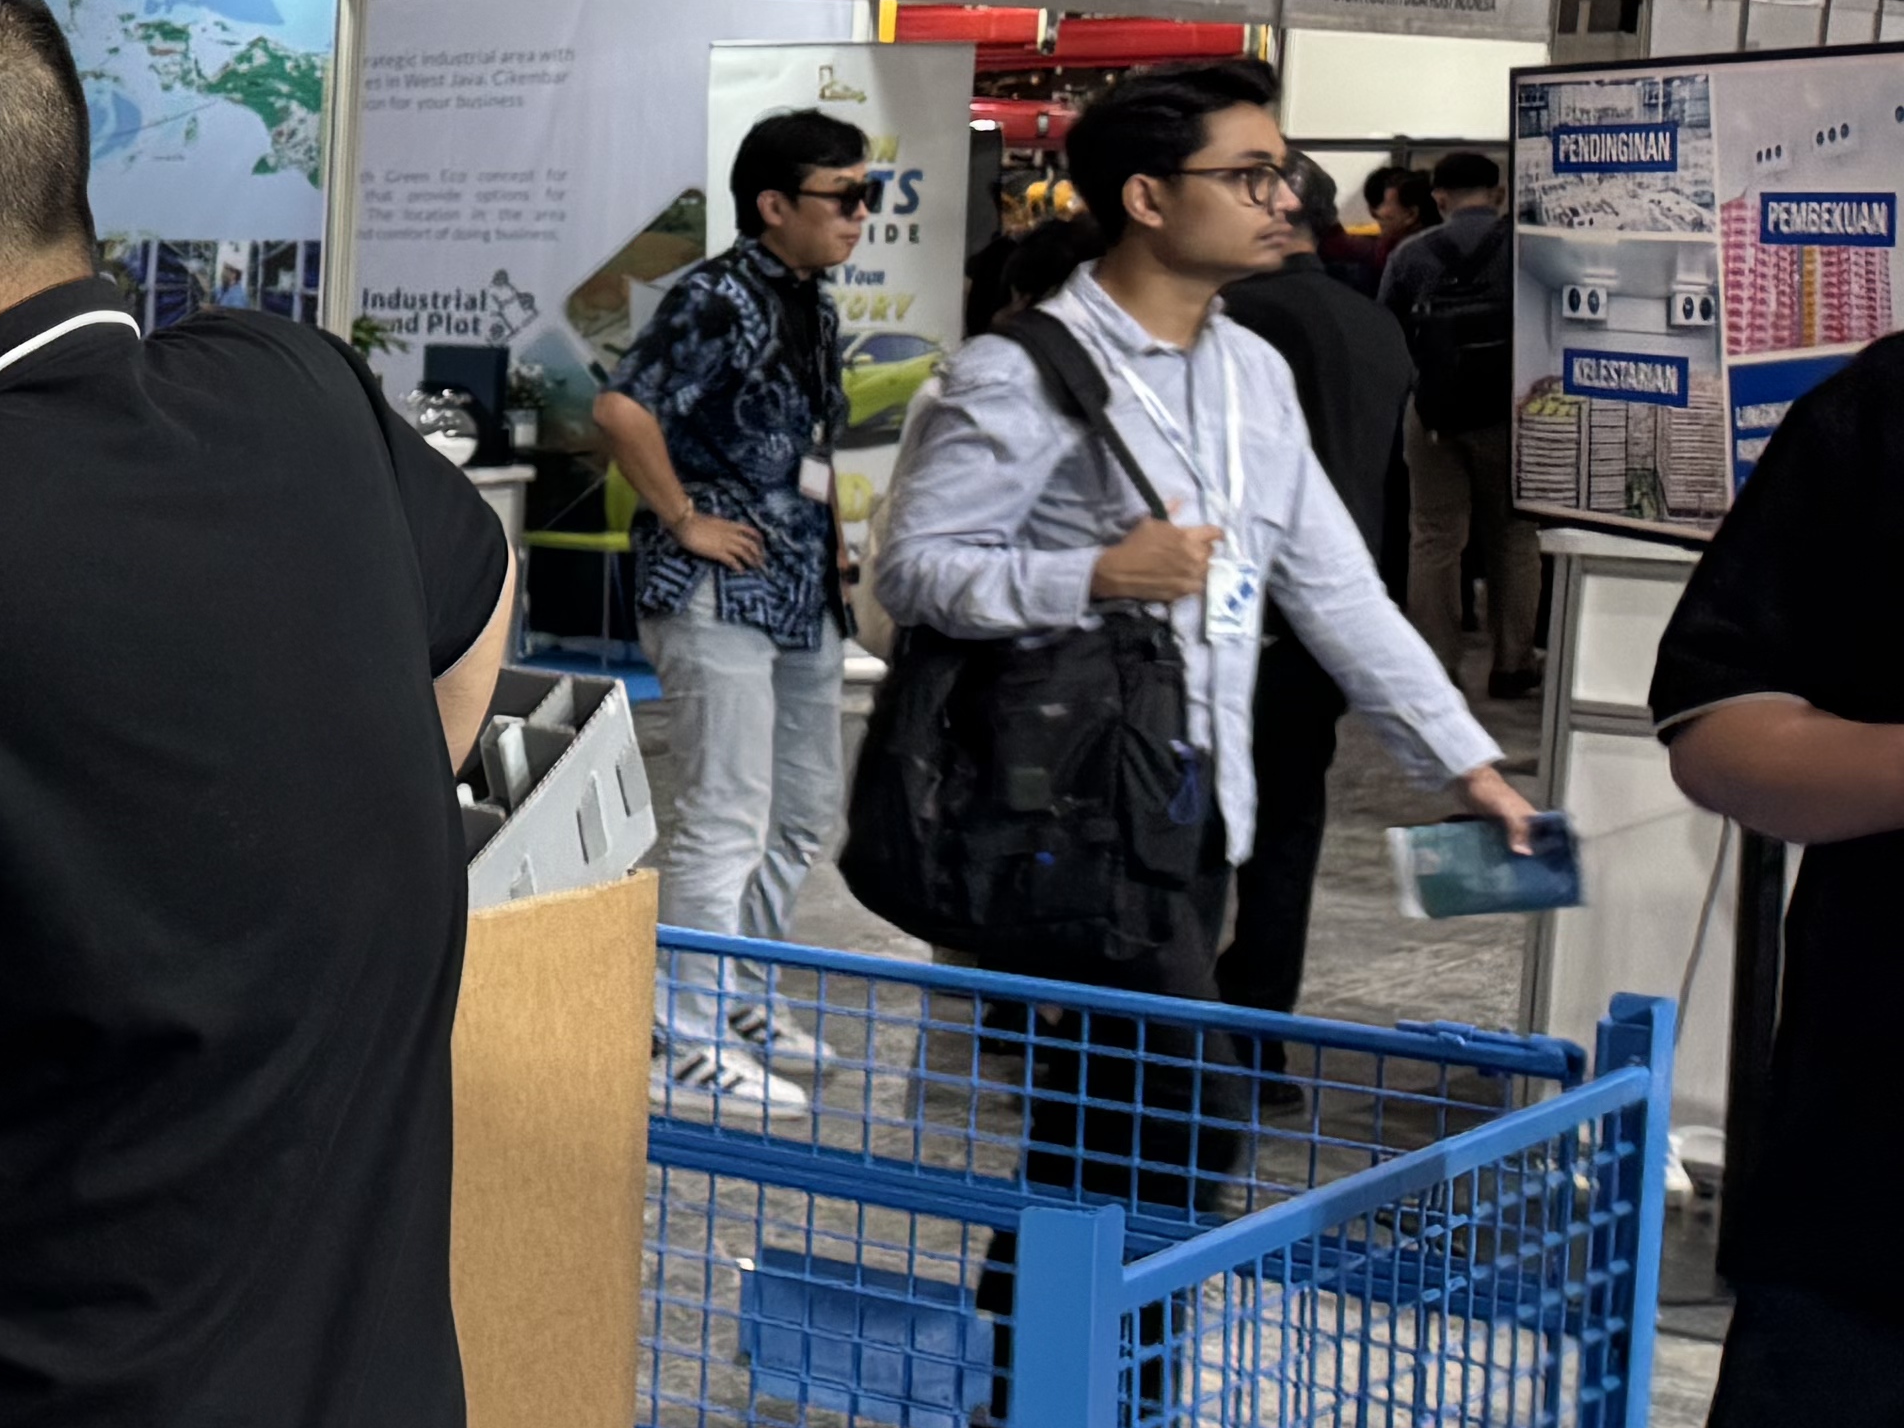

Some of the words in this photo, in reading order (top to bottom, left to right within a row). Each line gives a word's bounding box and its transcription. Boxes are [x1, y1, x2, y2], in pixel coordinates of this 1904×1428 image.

[1559, 132, 1672, 163] PENDINGINAN
[1768, 201, 1888, 236] PEMBEKUAN
[362, 288, 486, 312] Industrial
[382, 313, 419, 334] nd
[427, 313, 480, 335] Plot
